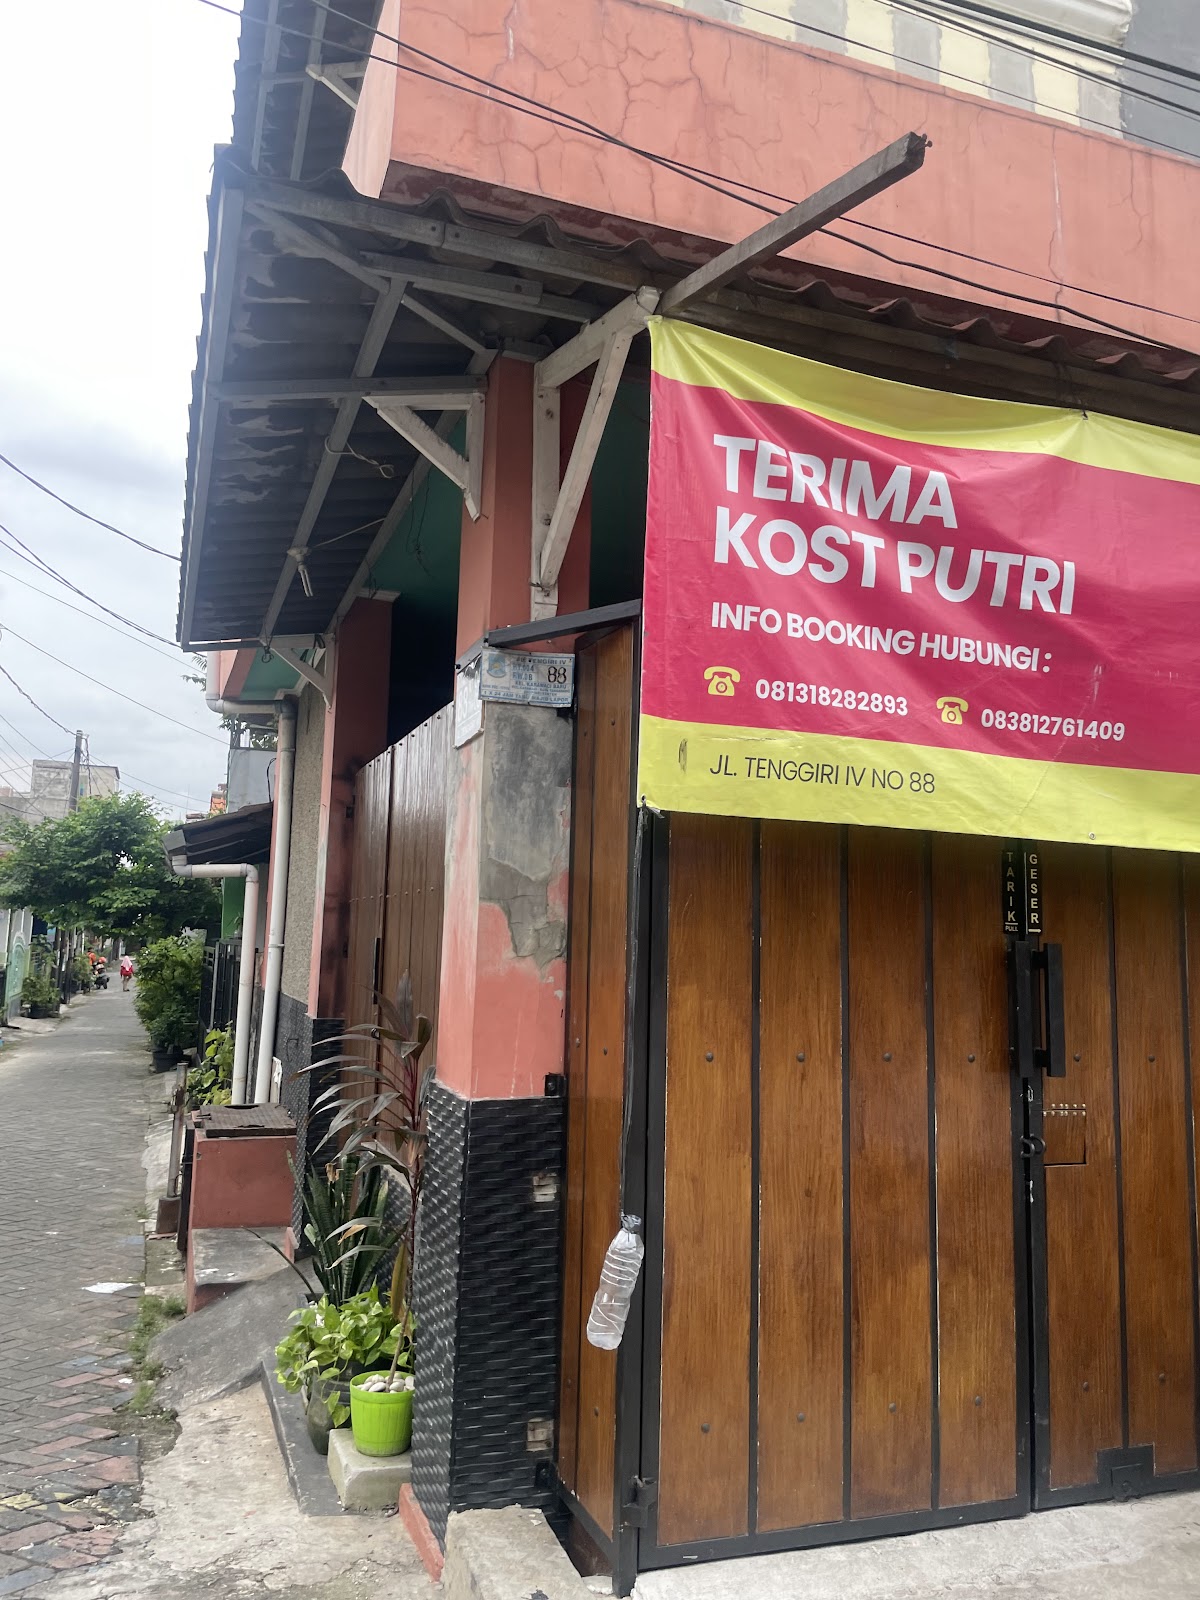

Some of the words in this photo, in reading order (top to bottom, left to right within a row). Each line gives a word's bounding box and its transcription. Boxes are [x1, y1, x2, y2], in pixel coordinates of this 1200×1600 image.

[713, 434, 958, 529] TERIMA
[714, 506, 885, 588] KOST
[896, 540, 1076, 615] PUTRI
[711, 602, 782, 634] INFO
[787, 613, 915, 655] BOOKING
[547, 665, 567, 684] 88
[755, 679, 908, 716] 081318282893
[980, 708, 1125, 741] 083812761409
[710, 754, 737, 778] JL.
[744, 757, 839, 785] TENGGIRI
[845, 766, 866, 786] IV
[872, 767, 903, 790] NO
[909, 771, 935, 794] 88
[1030, 854, 1040, 924] GESER
